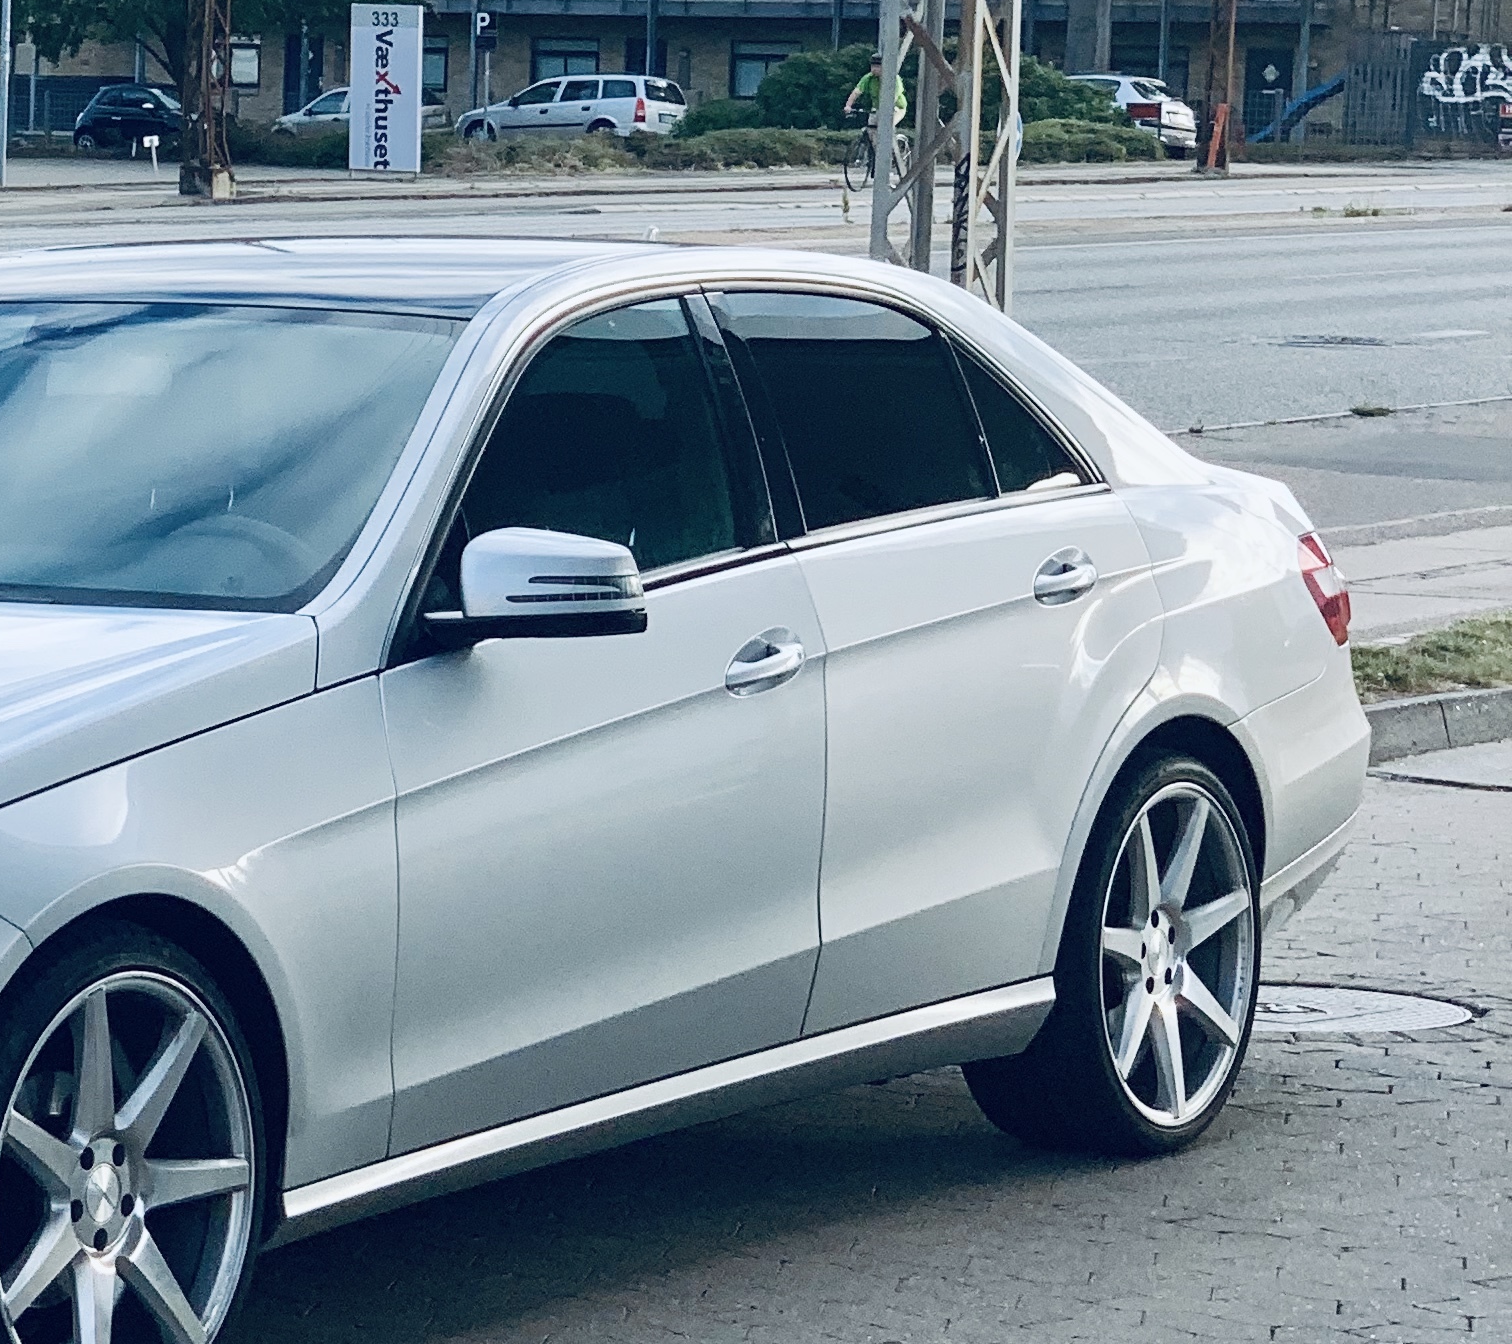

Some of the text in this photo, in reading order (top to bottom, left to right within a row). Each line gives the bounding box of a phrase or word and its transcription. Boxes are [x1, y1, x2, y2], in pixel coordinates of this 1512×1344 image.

[372, 11, 399, 27] 333
[477, 12, 490, 35] P
[374, 28, 401, 169] Væxthuset
